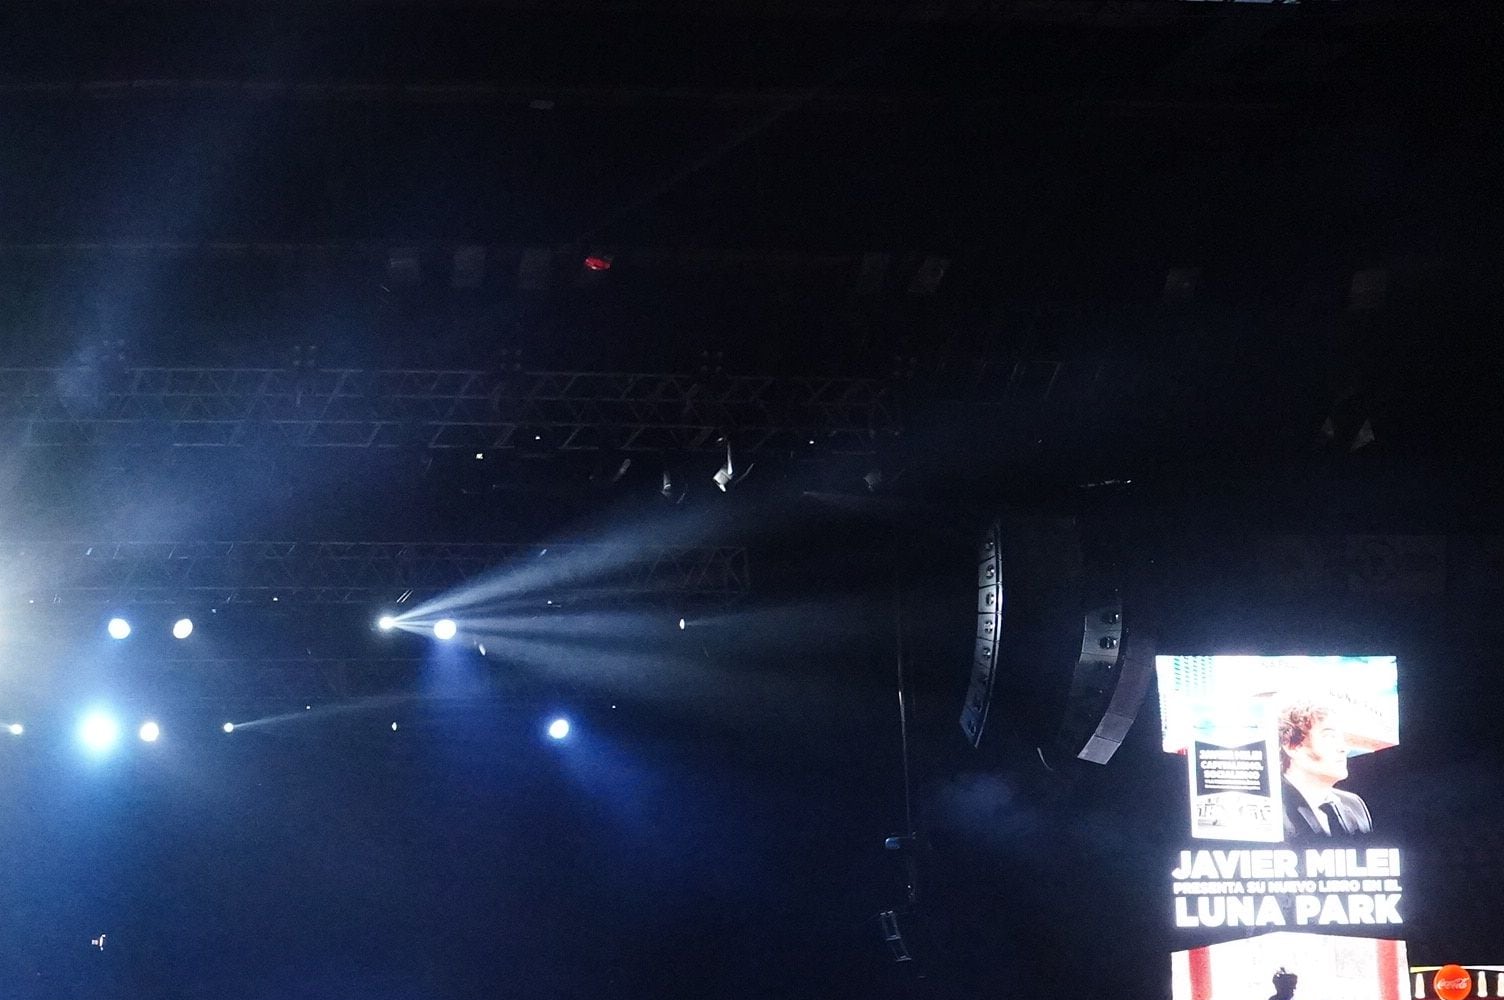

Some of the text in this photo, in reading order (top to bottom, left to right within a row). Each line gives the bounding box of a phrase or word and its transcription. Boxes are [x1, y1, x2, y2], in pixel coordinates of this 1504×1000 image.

[1172, 848, 1401, 879] JAVIER MILEI
[1175, 893, 1403, 927] LUNA PARK
